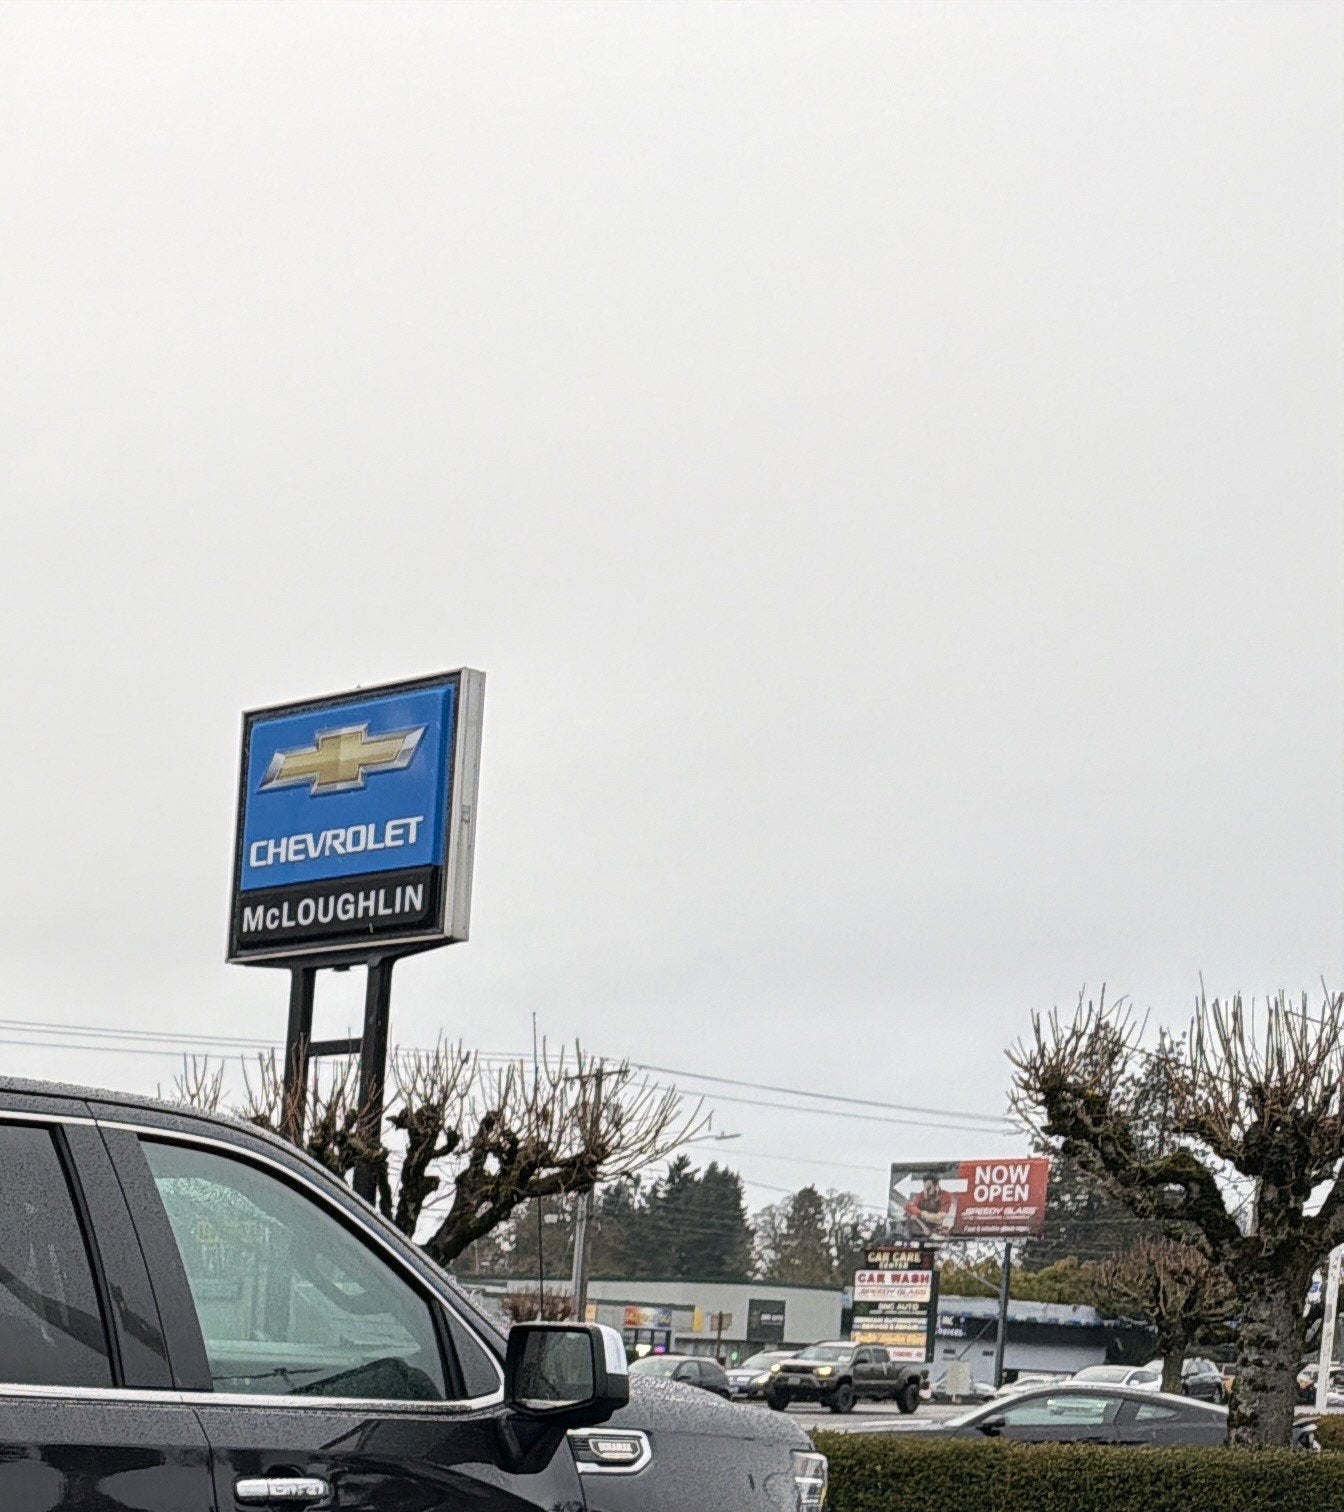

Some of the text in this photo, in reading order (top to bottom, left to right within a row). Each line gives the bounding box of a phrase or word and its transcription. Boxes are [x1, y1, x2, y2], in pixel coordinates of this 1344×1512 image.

[250, 816, 424, 868] CHEVROLET
[242, 883, 424, 933] McLOUGHLIN
[974, 1164, 1030, 1184] NOW
[973, 1184, 1030, 1203] OPEN
[857, 1273, 930, 1284] CAR WASH
